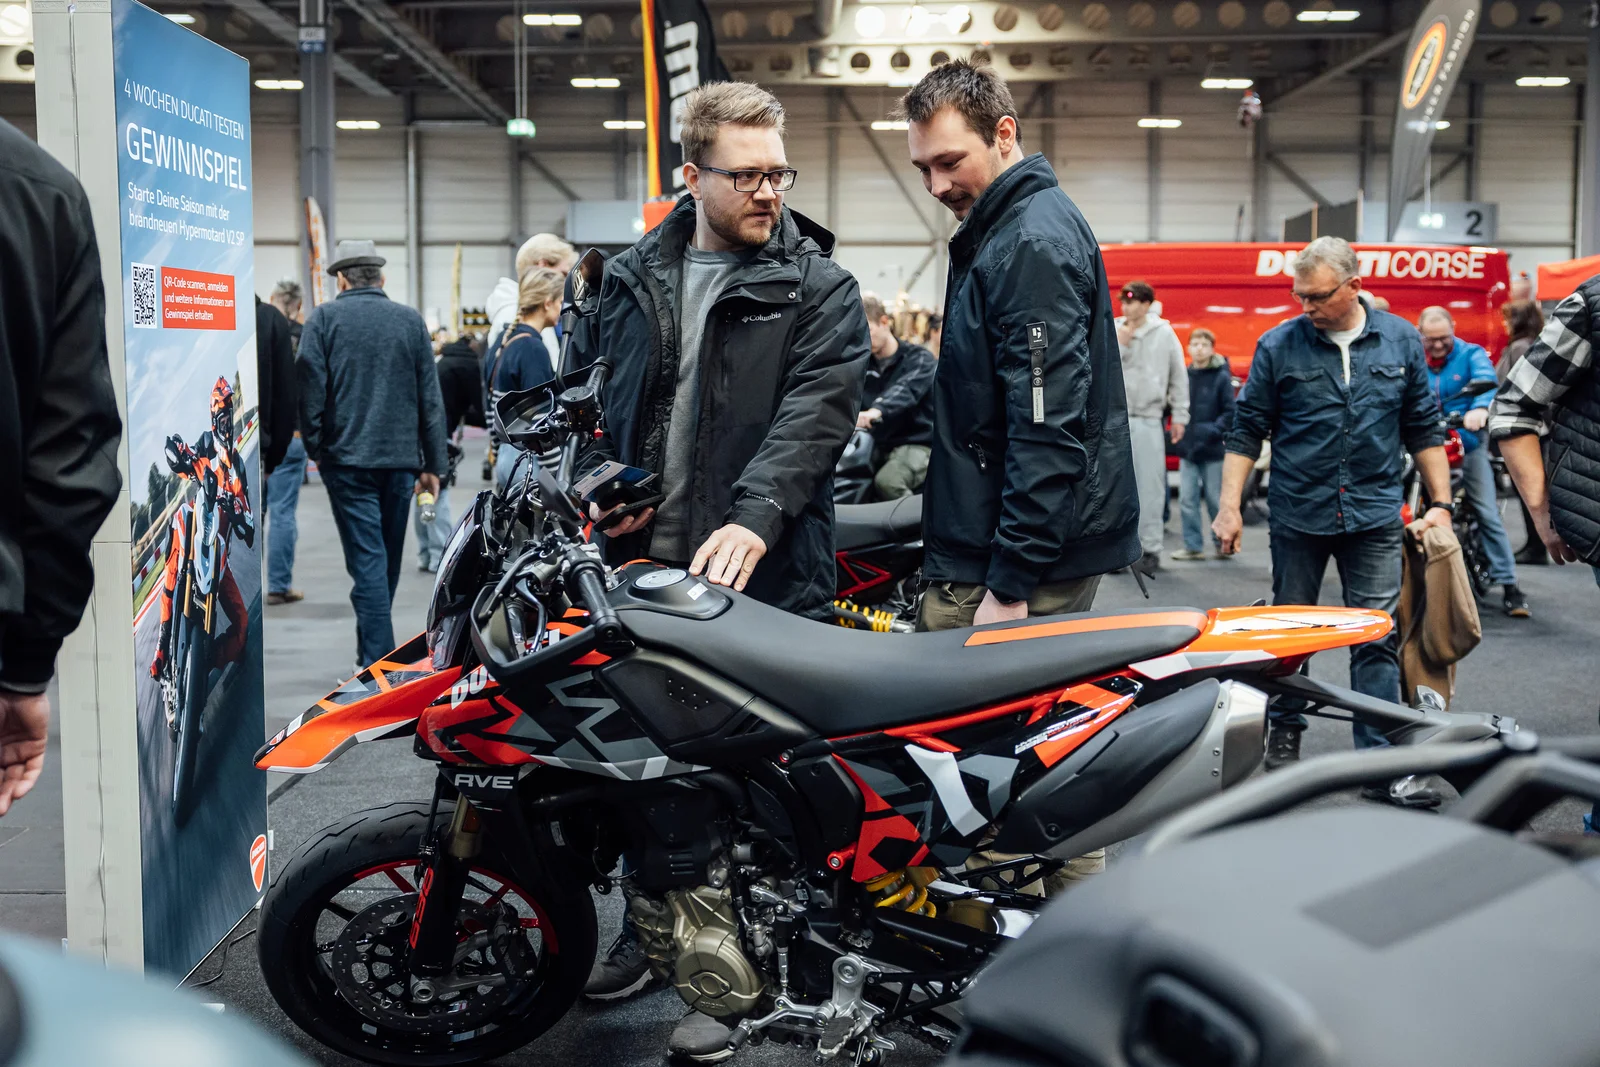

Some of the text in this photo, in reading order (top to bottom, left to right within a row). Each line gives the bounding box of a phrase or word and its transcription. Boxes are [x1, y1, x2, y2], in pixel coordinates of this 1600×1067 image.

[124, 78, 244, 141] 4 WOCHEN DUCATI TESTEN
[126, 122, 247, 191] GEWINNSPIEL
[127, 181, 230, 221] Starte Deine Saison mit der
[129, 208, 245, 247] brandneuen Hypermotard V2 SP
[1466, 210, 1484, 237] 2
[163, 275, 229, 293] QR-Code scannen, anmelden
[164, 292, 234, 308] und weitere Informationen zum
[164, 307, 214, 322] Gewinnspiel erhalten
[750, 311, 782, 322] Columbia
